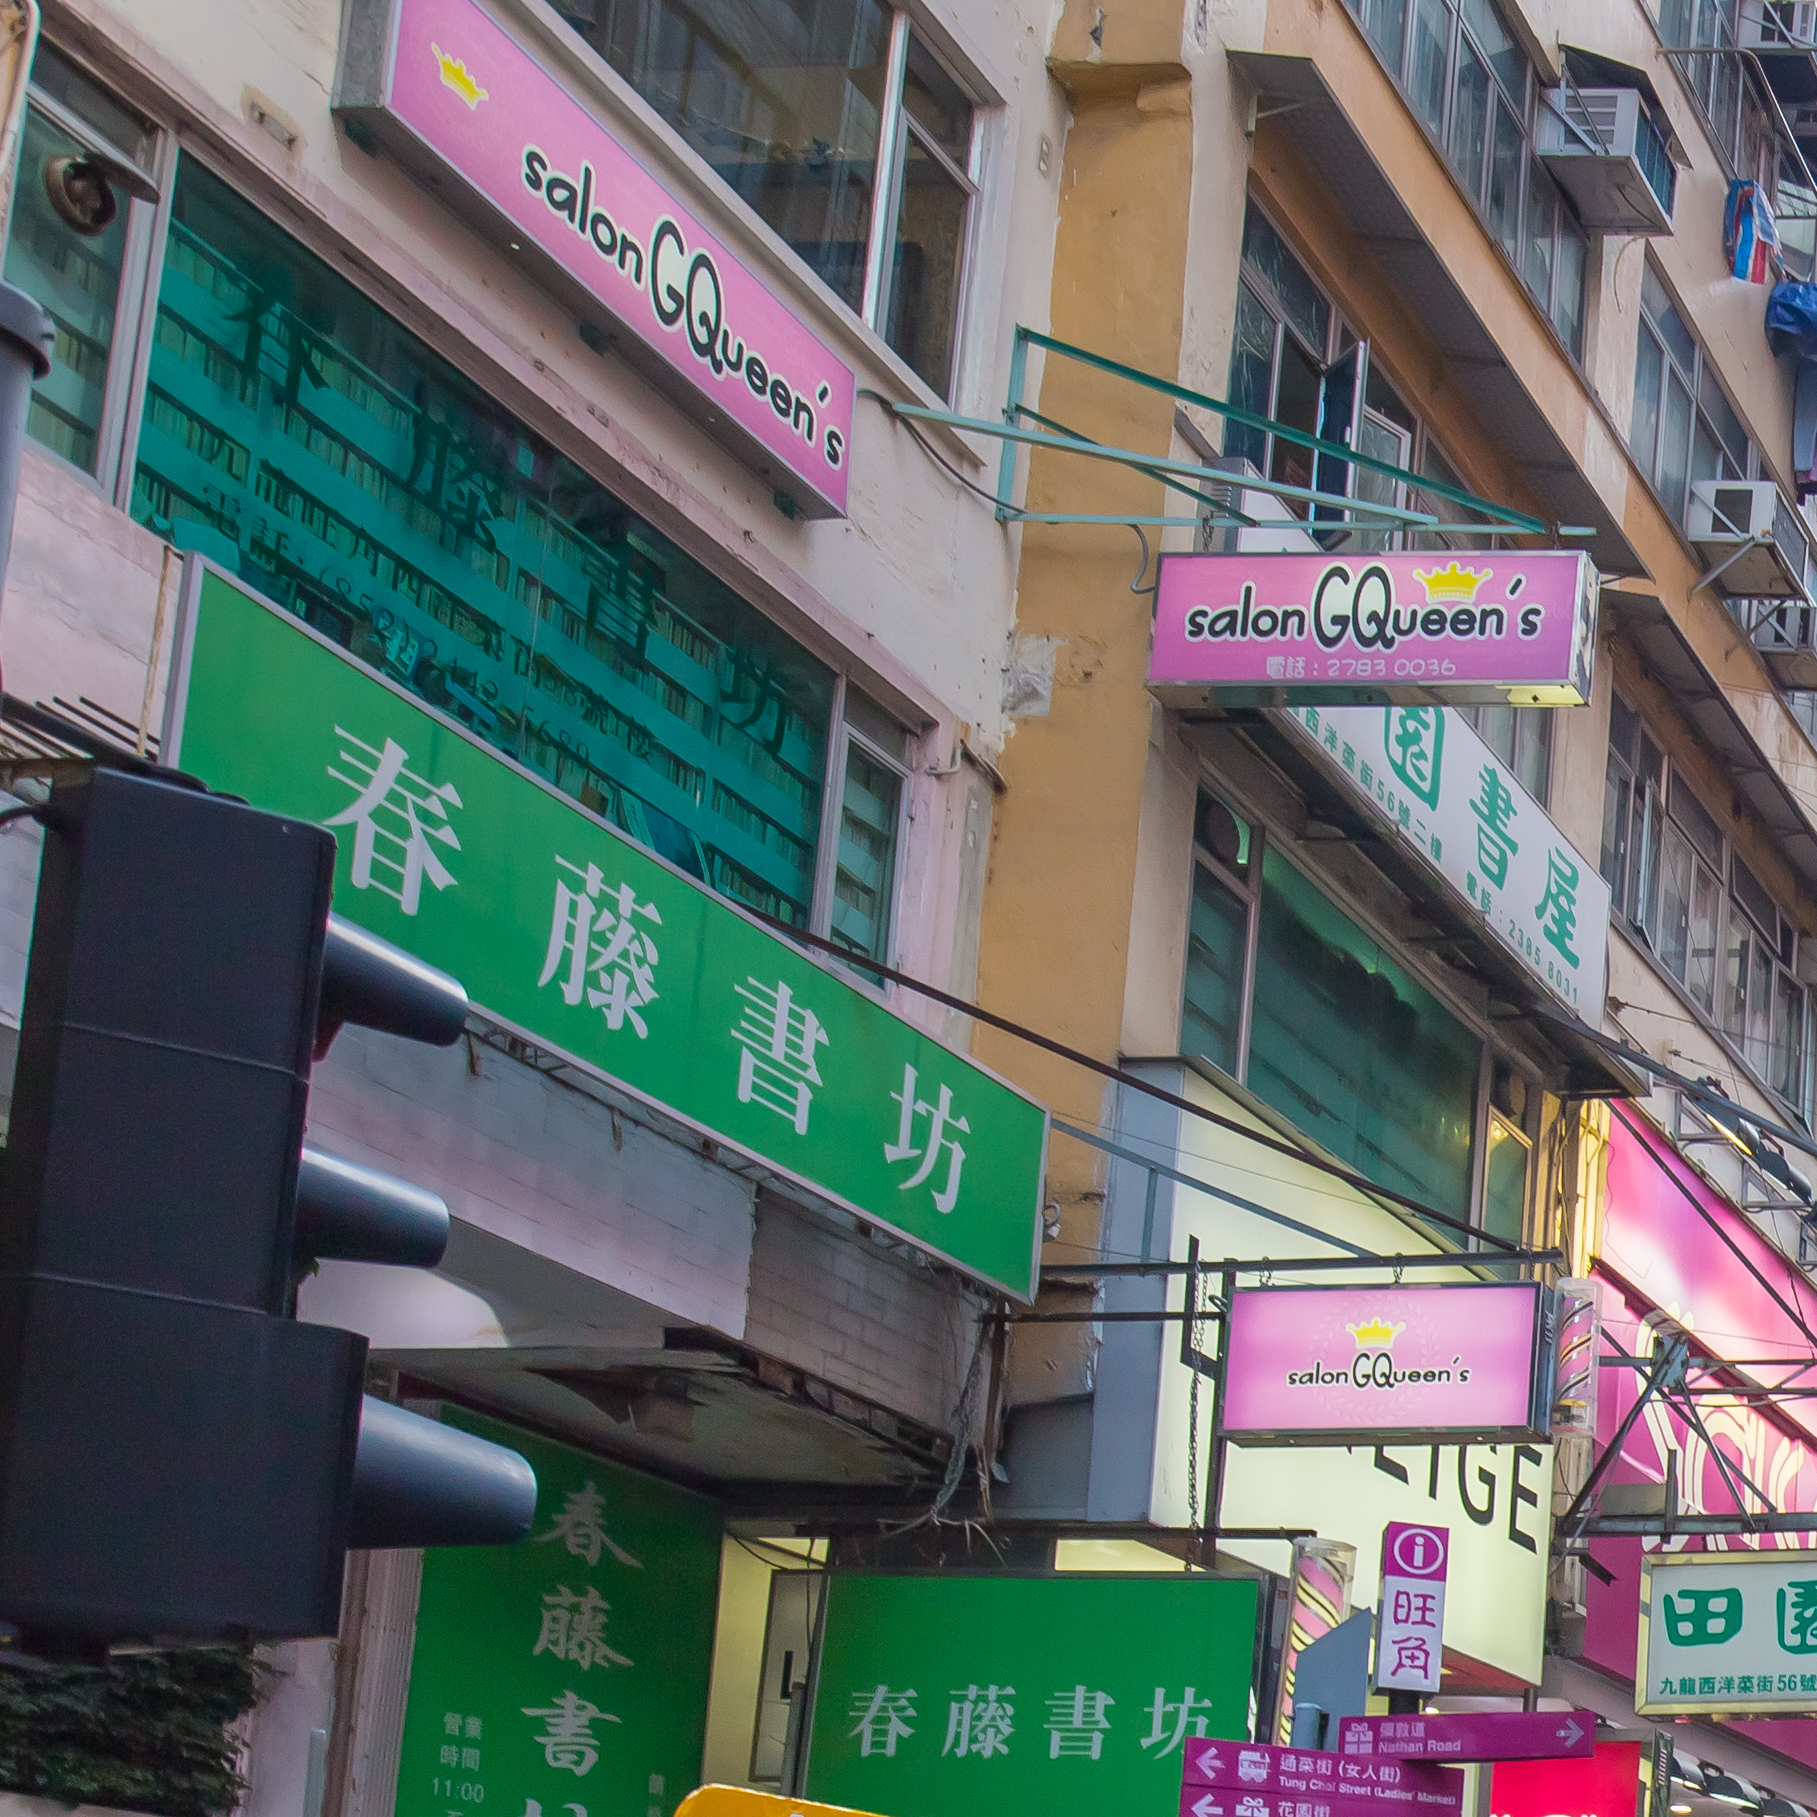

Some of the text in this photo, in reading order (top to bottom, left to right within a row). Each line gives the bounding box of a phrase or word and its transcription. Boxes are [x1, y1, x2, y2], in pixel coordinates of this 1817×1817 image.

[1326, 658, 1456, 677] 2783 0036
[324, 723, 972, 1215] 春藤書坊
[1507, 918, 1581, 1006] 2385 8031
[1391, 1590, 1437, 1682] 旺角
[847, 1685, 1213, 1763] 春藤書坊
[440, 1745, 481, 1773] 時間
[1378, 1738, 1462, 1754] Nathan Road
[432, 1777, 485, 1804] 11:00
[1279, 1777, 1306, 1793] Tung
[1339, 1782, 1371, 1797] Street
